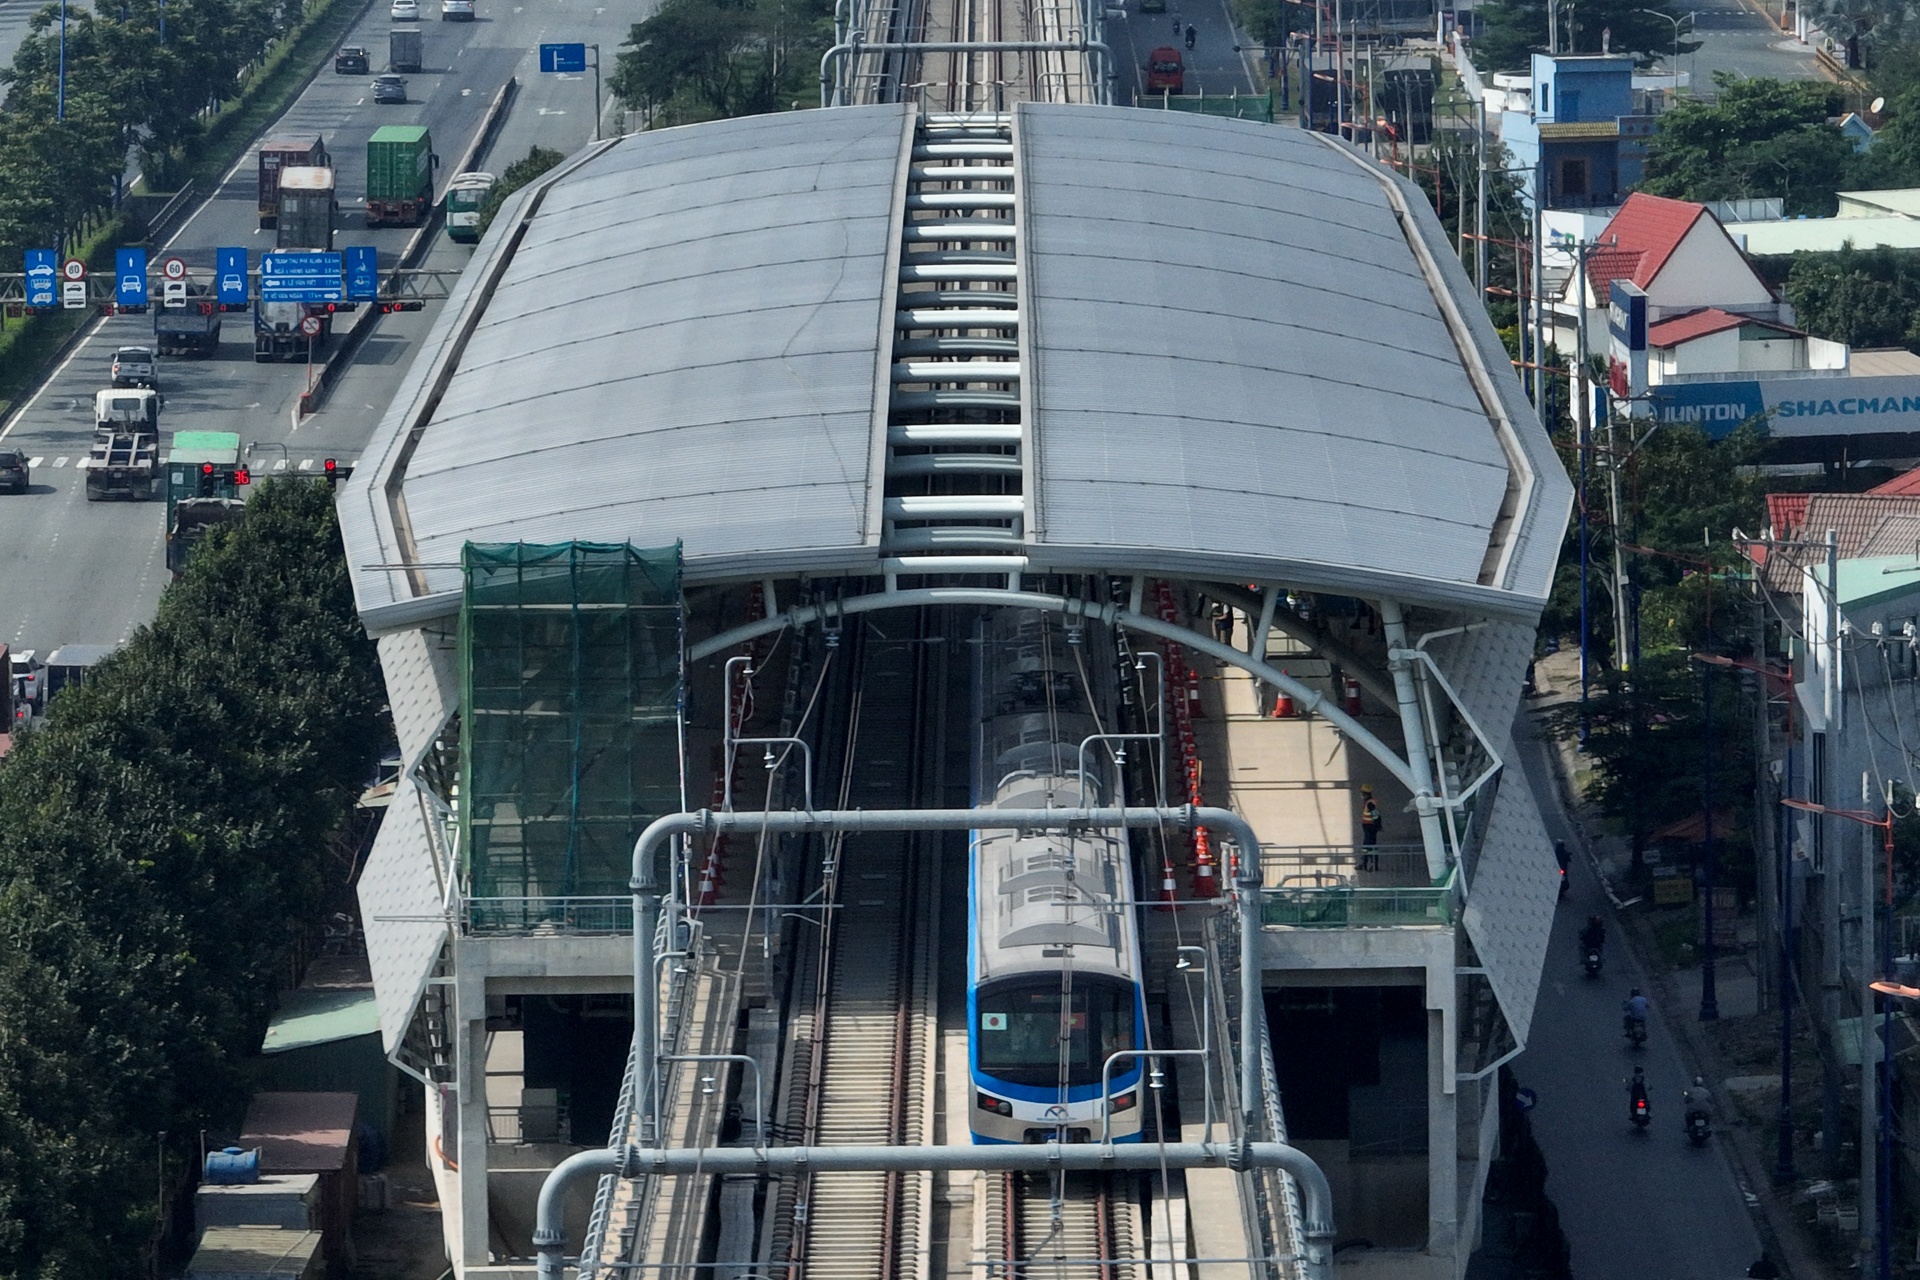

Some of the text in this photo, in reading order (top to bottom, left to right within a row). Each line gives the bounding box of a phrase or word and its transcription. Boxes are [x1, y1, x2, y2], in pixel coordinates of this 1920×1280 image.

[68, 264, 80, 275] 80
[169, 264, 180, 274] 60
[1777, 396, 1920, 418] SHACMAN
[234, 470, 249, 485] 36
